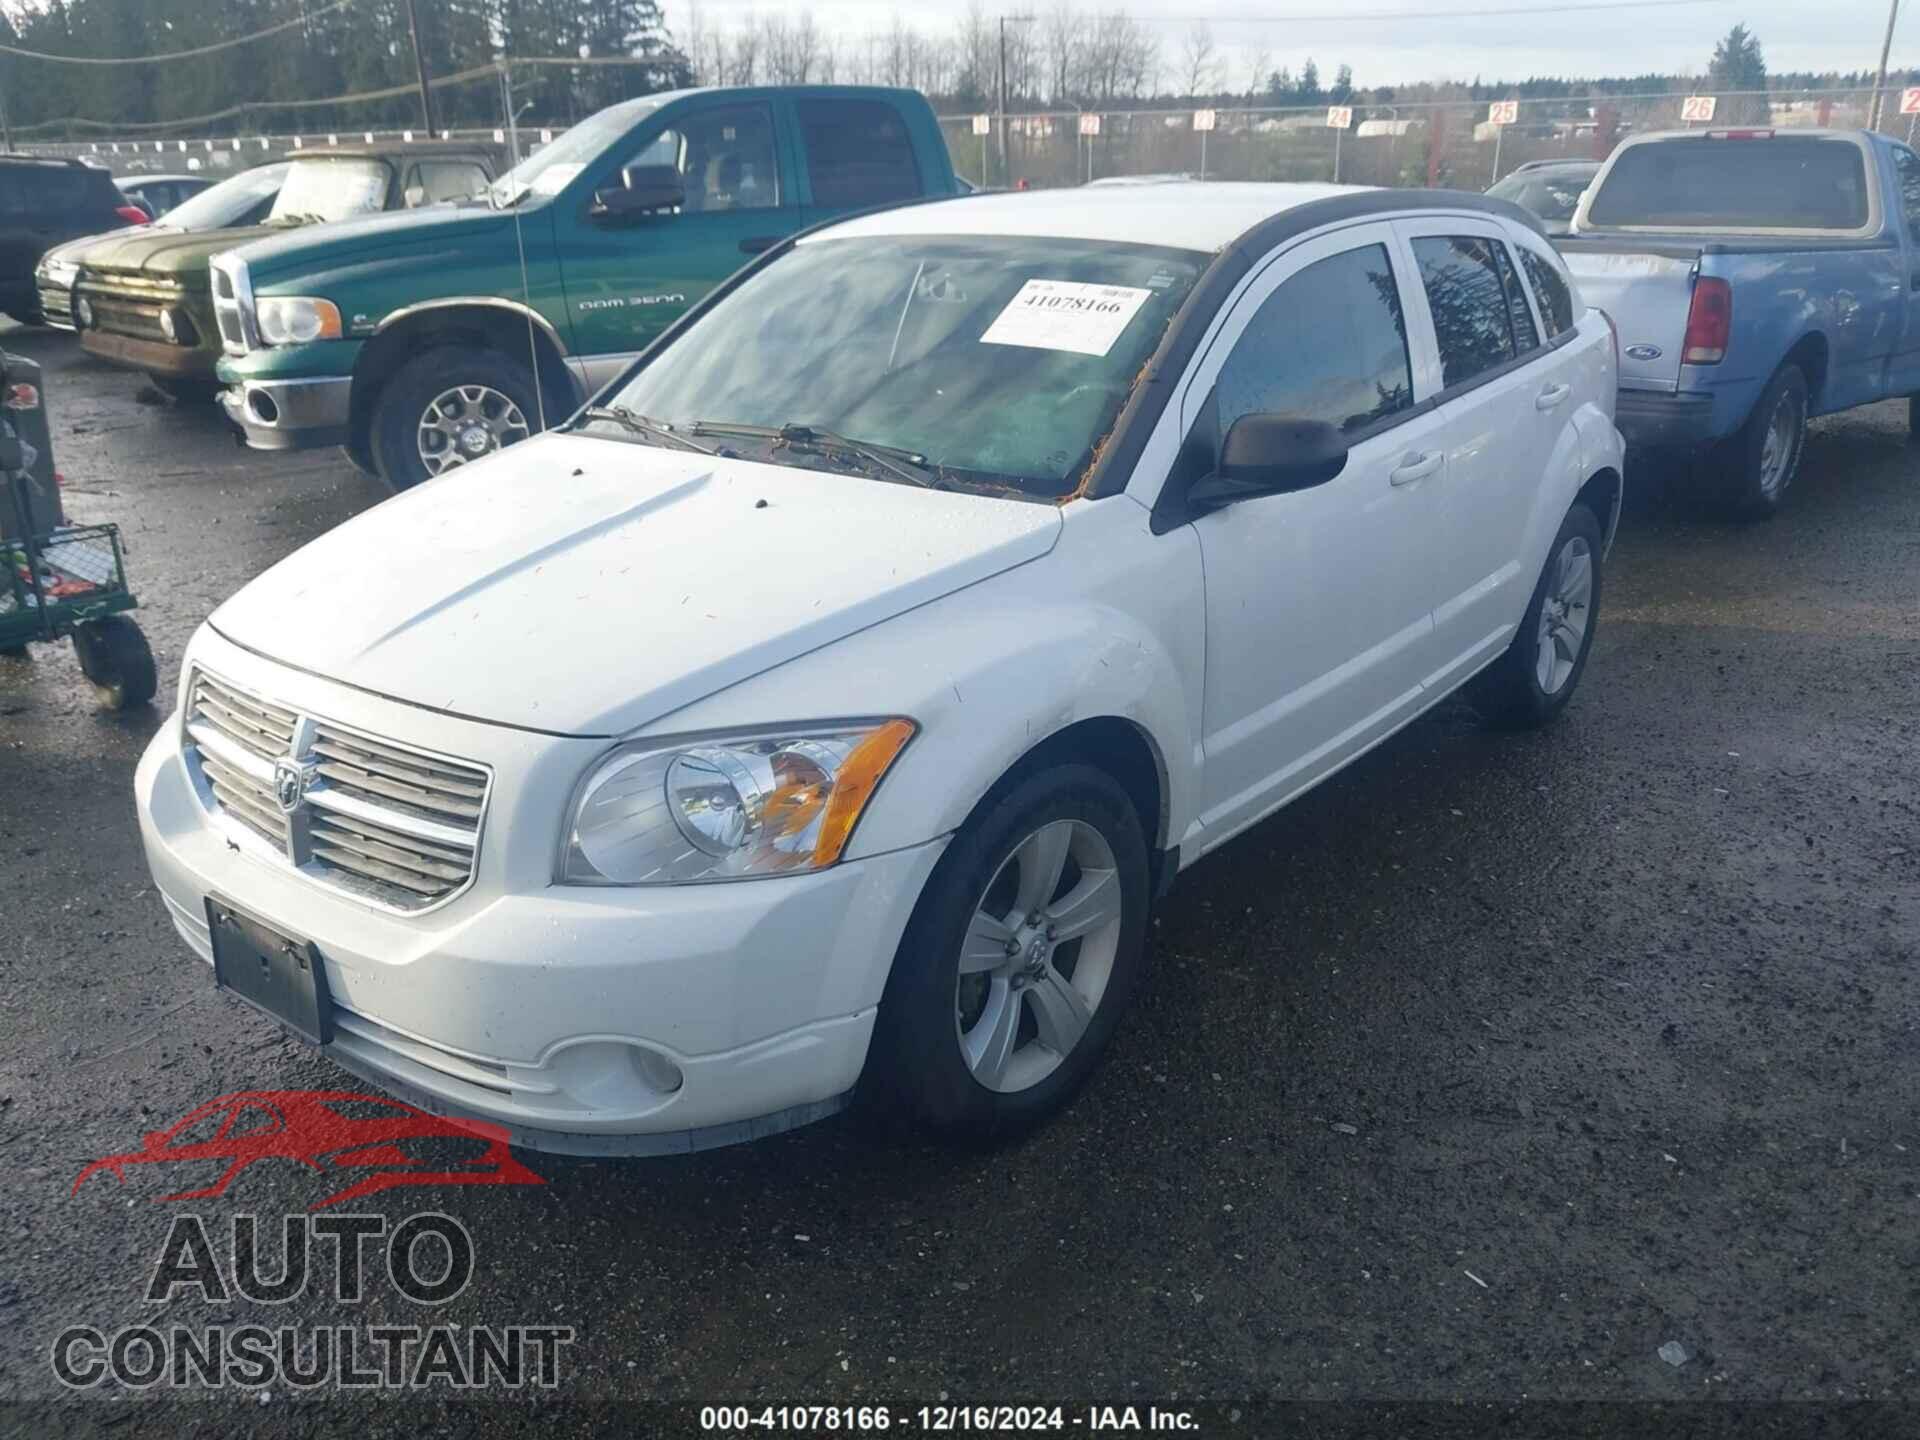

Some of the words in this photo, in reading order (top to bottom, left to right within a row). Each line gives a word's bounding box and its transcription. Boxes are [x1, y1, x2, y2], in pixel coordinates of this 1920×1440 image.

[1491, 103, 1514, 123] 25
[1685, 97, 1711, 118] 26
[1328, 108, 1350, 127] 24
[579, 299, 624, 310] RAM
[1024, 295, 1120, 312] 41078166
